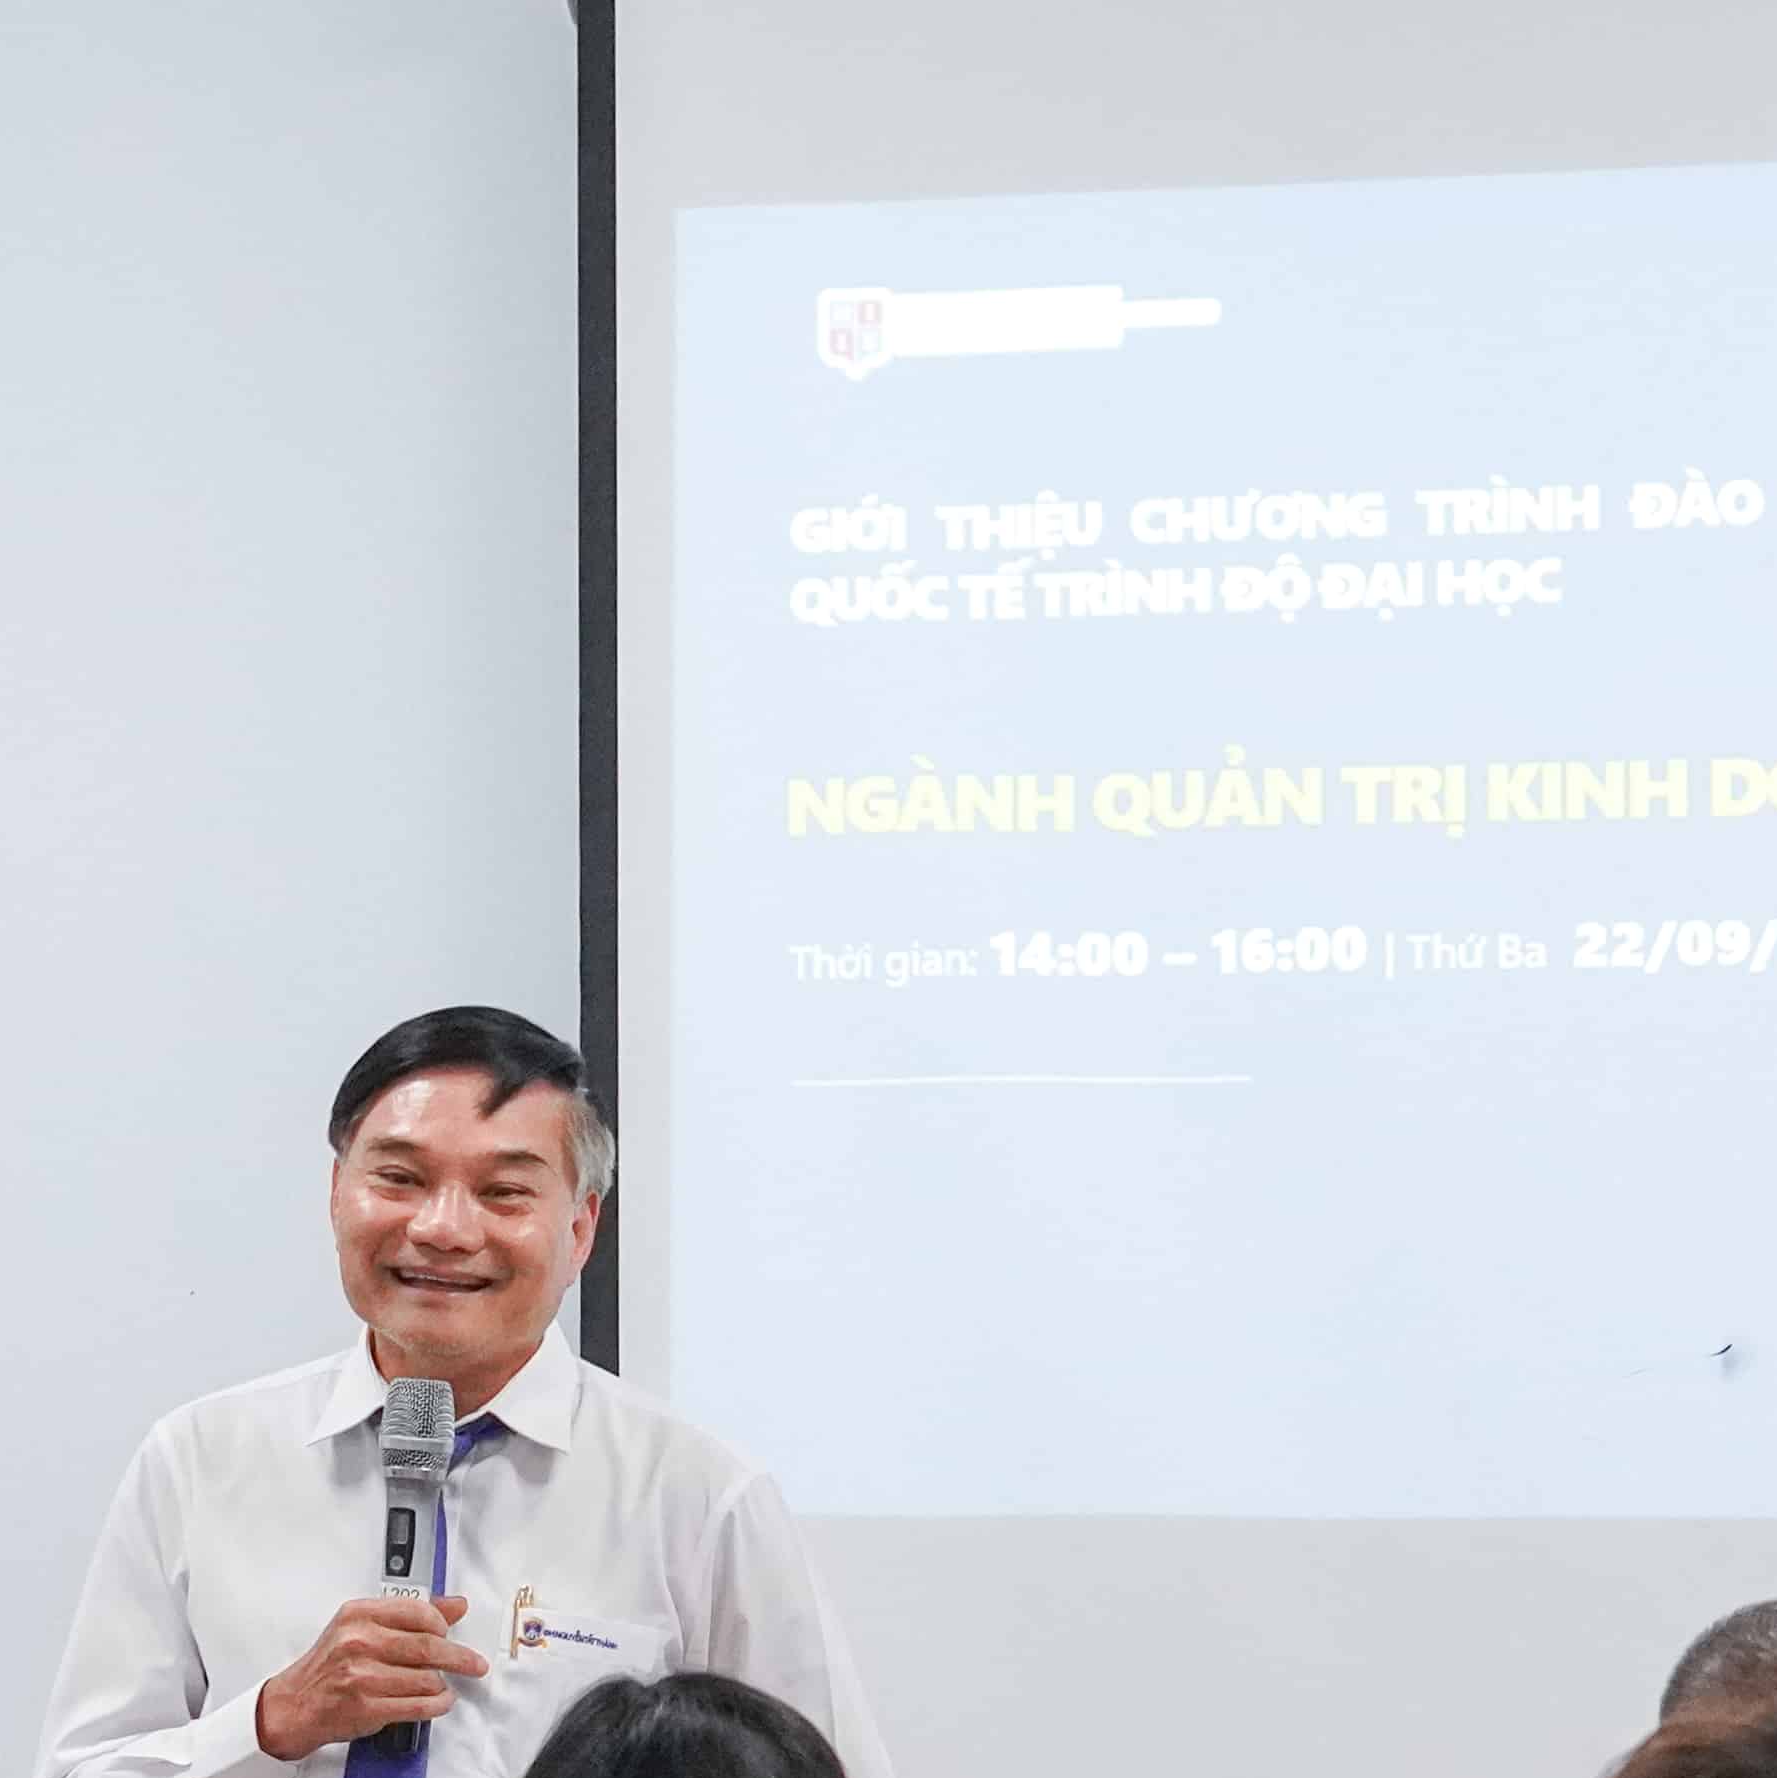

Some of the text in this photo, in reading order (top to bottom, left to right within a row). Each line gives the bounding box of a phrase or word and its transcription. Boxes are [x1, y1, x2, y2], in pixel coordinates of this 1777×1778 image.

[789, 493, 908, 553] GIỚI
[933, 489, 1103, 560] THIỆU
[1130, 487, 1388, 544] CHƯƠNG
[1415, 474, 1600, 536] TRÌNH
[1628, 467, 1765, 529] ĐÀO
[789, 553, 1562, 627] QUỐC TẾ TRÌNH ĐỘ ĐẠI HỌC
[788, 754, 1075, 836] NGÀNH
[1093, 745, 1322, 837] QUẢN
[1341, 765, 1467, 838] TRỊ
[1487, 759, 1689, 821] KINH
[789, 942, 872, 981] Thời
[885, 942, 978, 988] gian:
[989, 930, 1149, 977] 14:00
[1210, 926, 1368, 974] 16:00
[1406, 932, 1487, 970] Thứ
[1498, 934, 1547, 970] Ba
